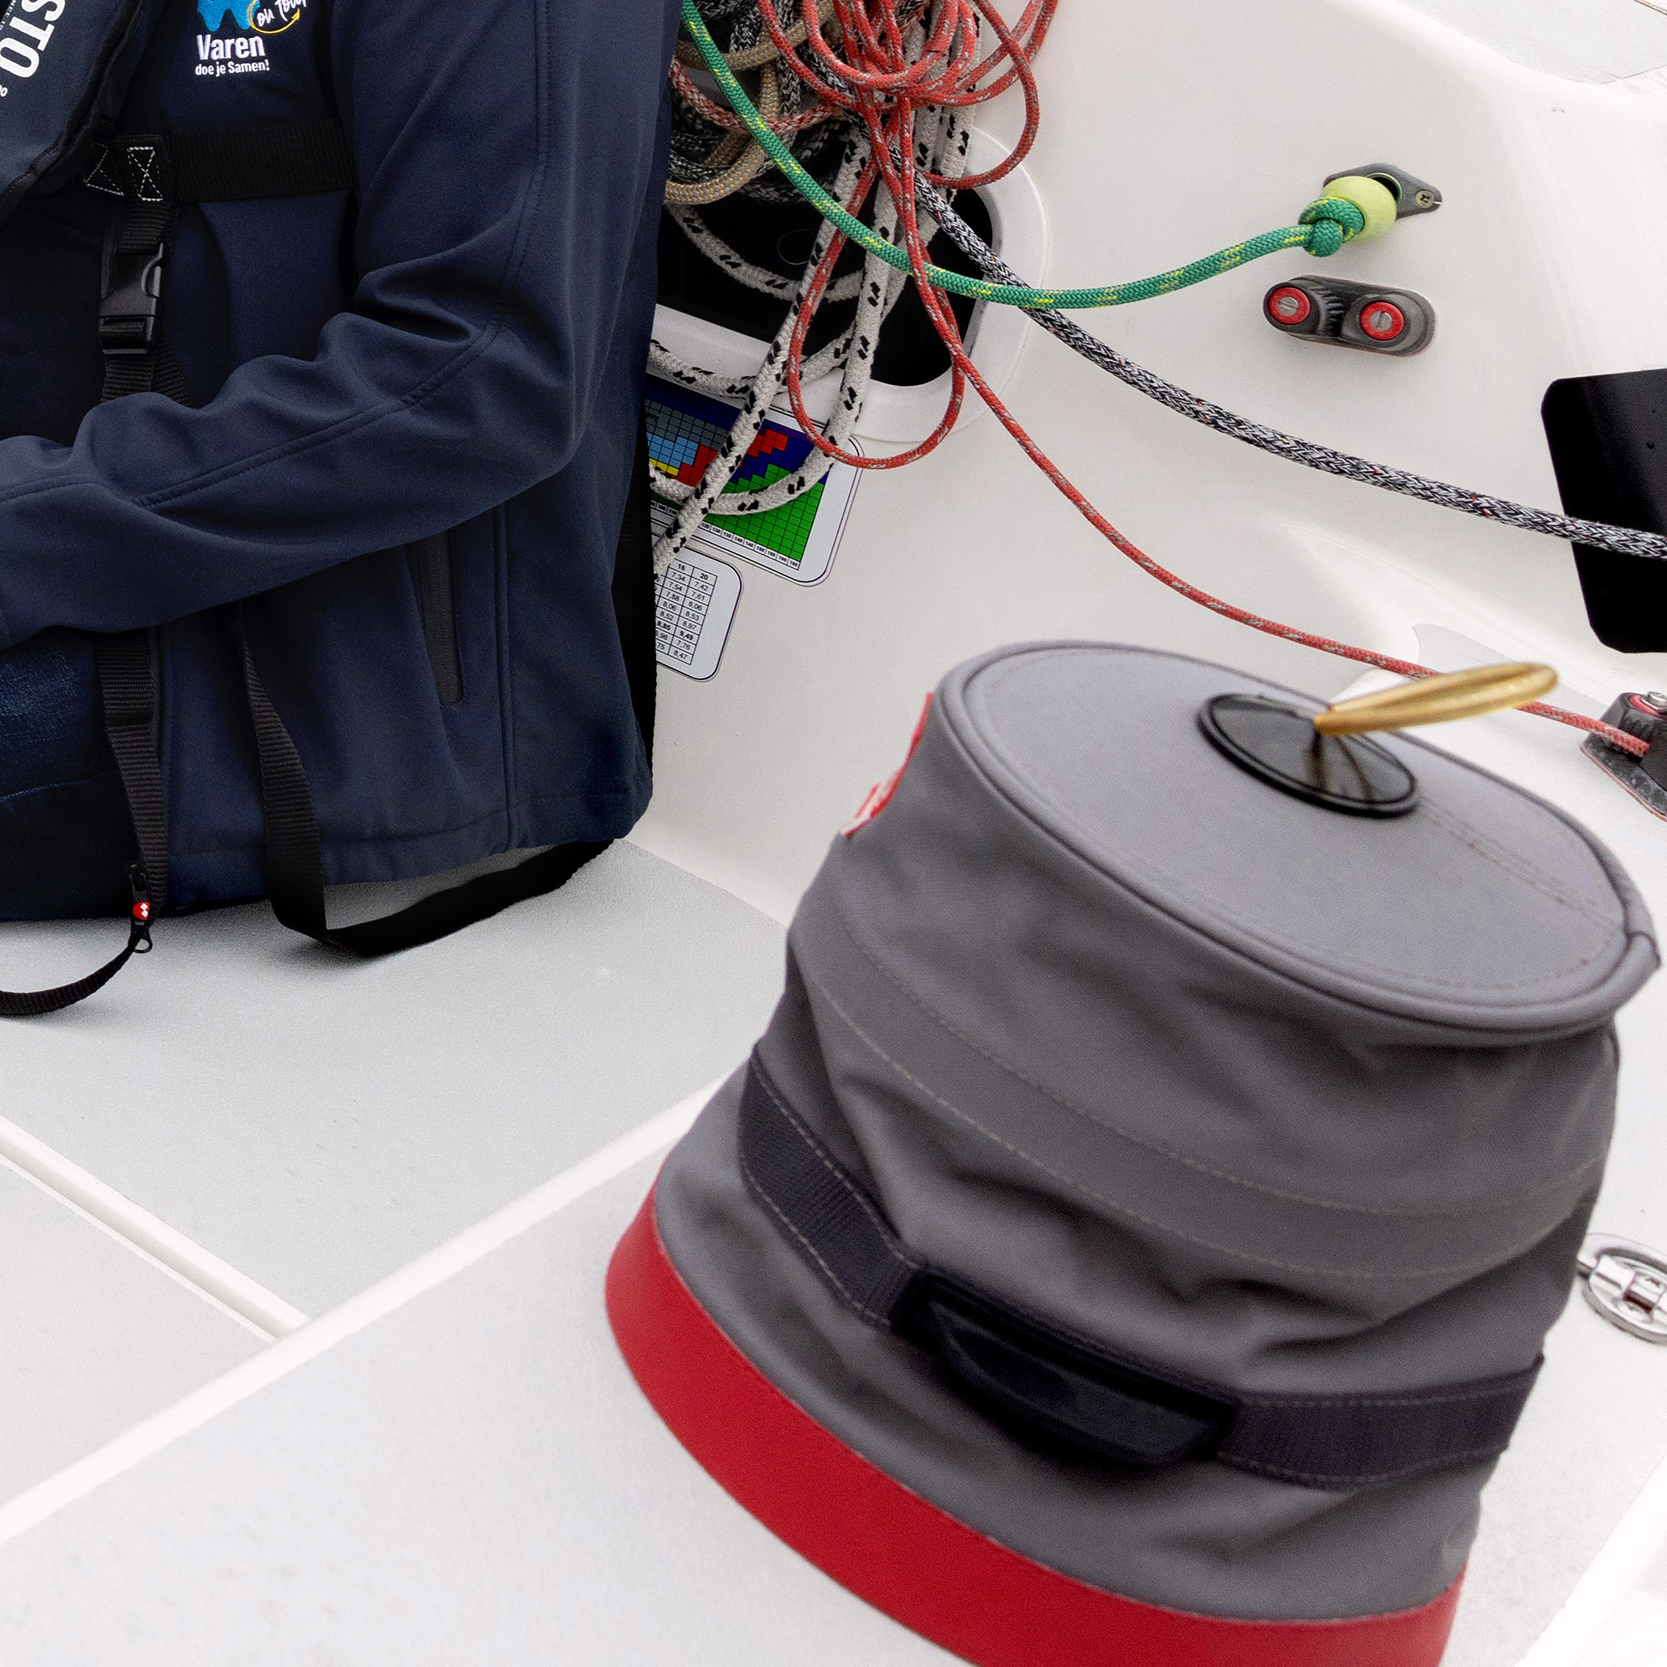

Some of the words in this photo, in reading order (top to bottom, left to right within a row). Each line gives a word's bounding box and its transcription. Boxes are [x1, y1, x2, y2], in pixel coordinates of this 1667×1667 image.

[196, 34, 266, 61] Varen
[194, 63, 215, 76] doe
[215, 61, 226, 77] je
[227, 59, 270, 73] Samen!
[677, 563, 686, 572] 16
[699, 572, 709, 581] 20
